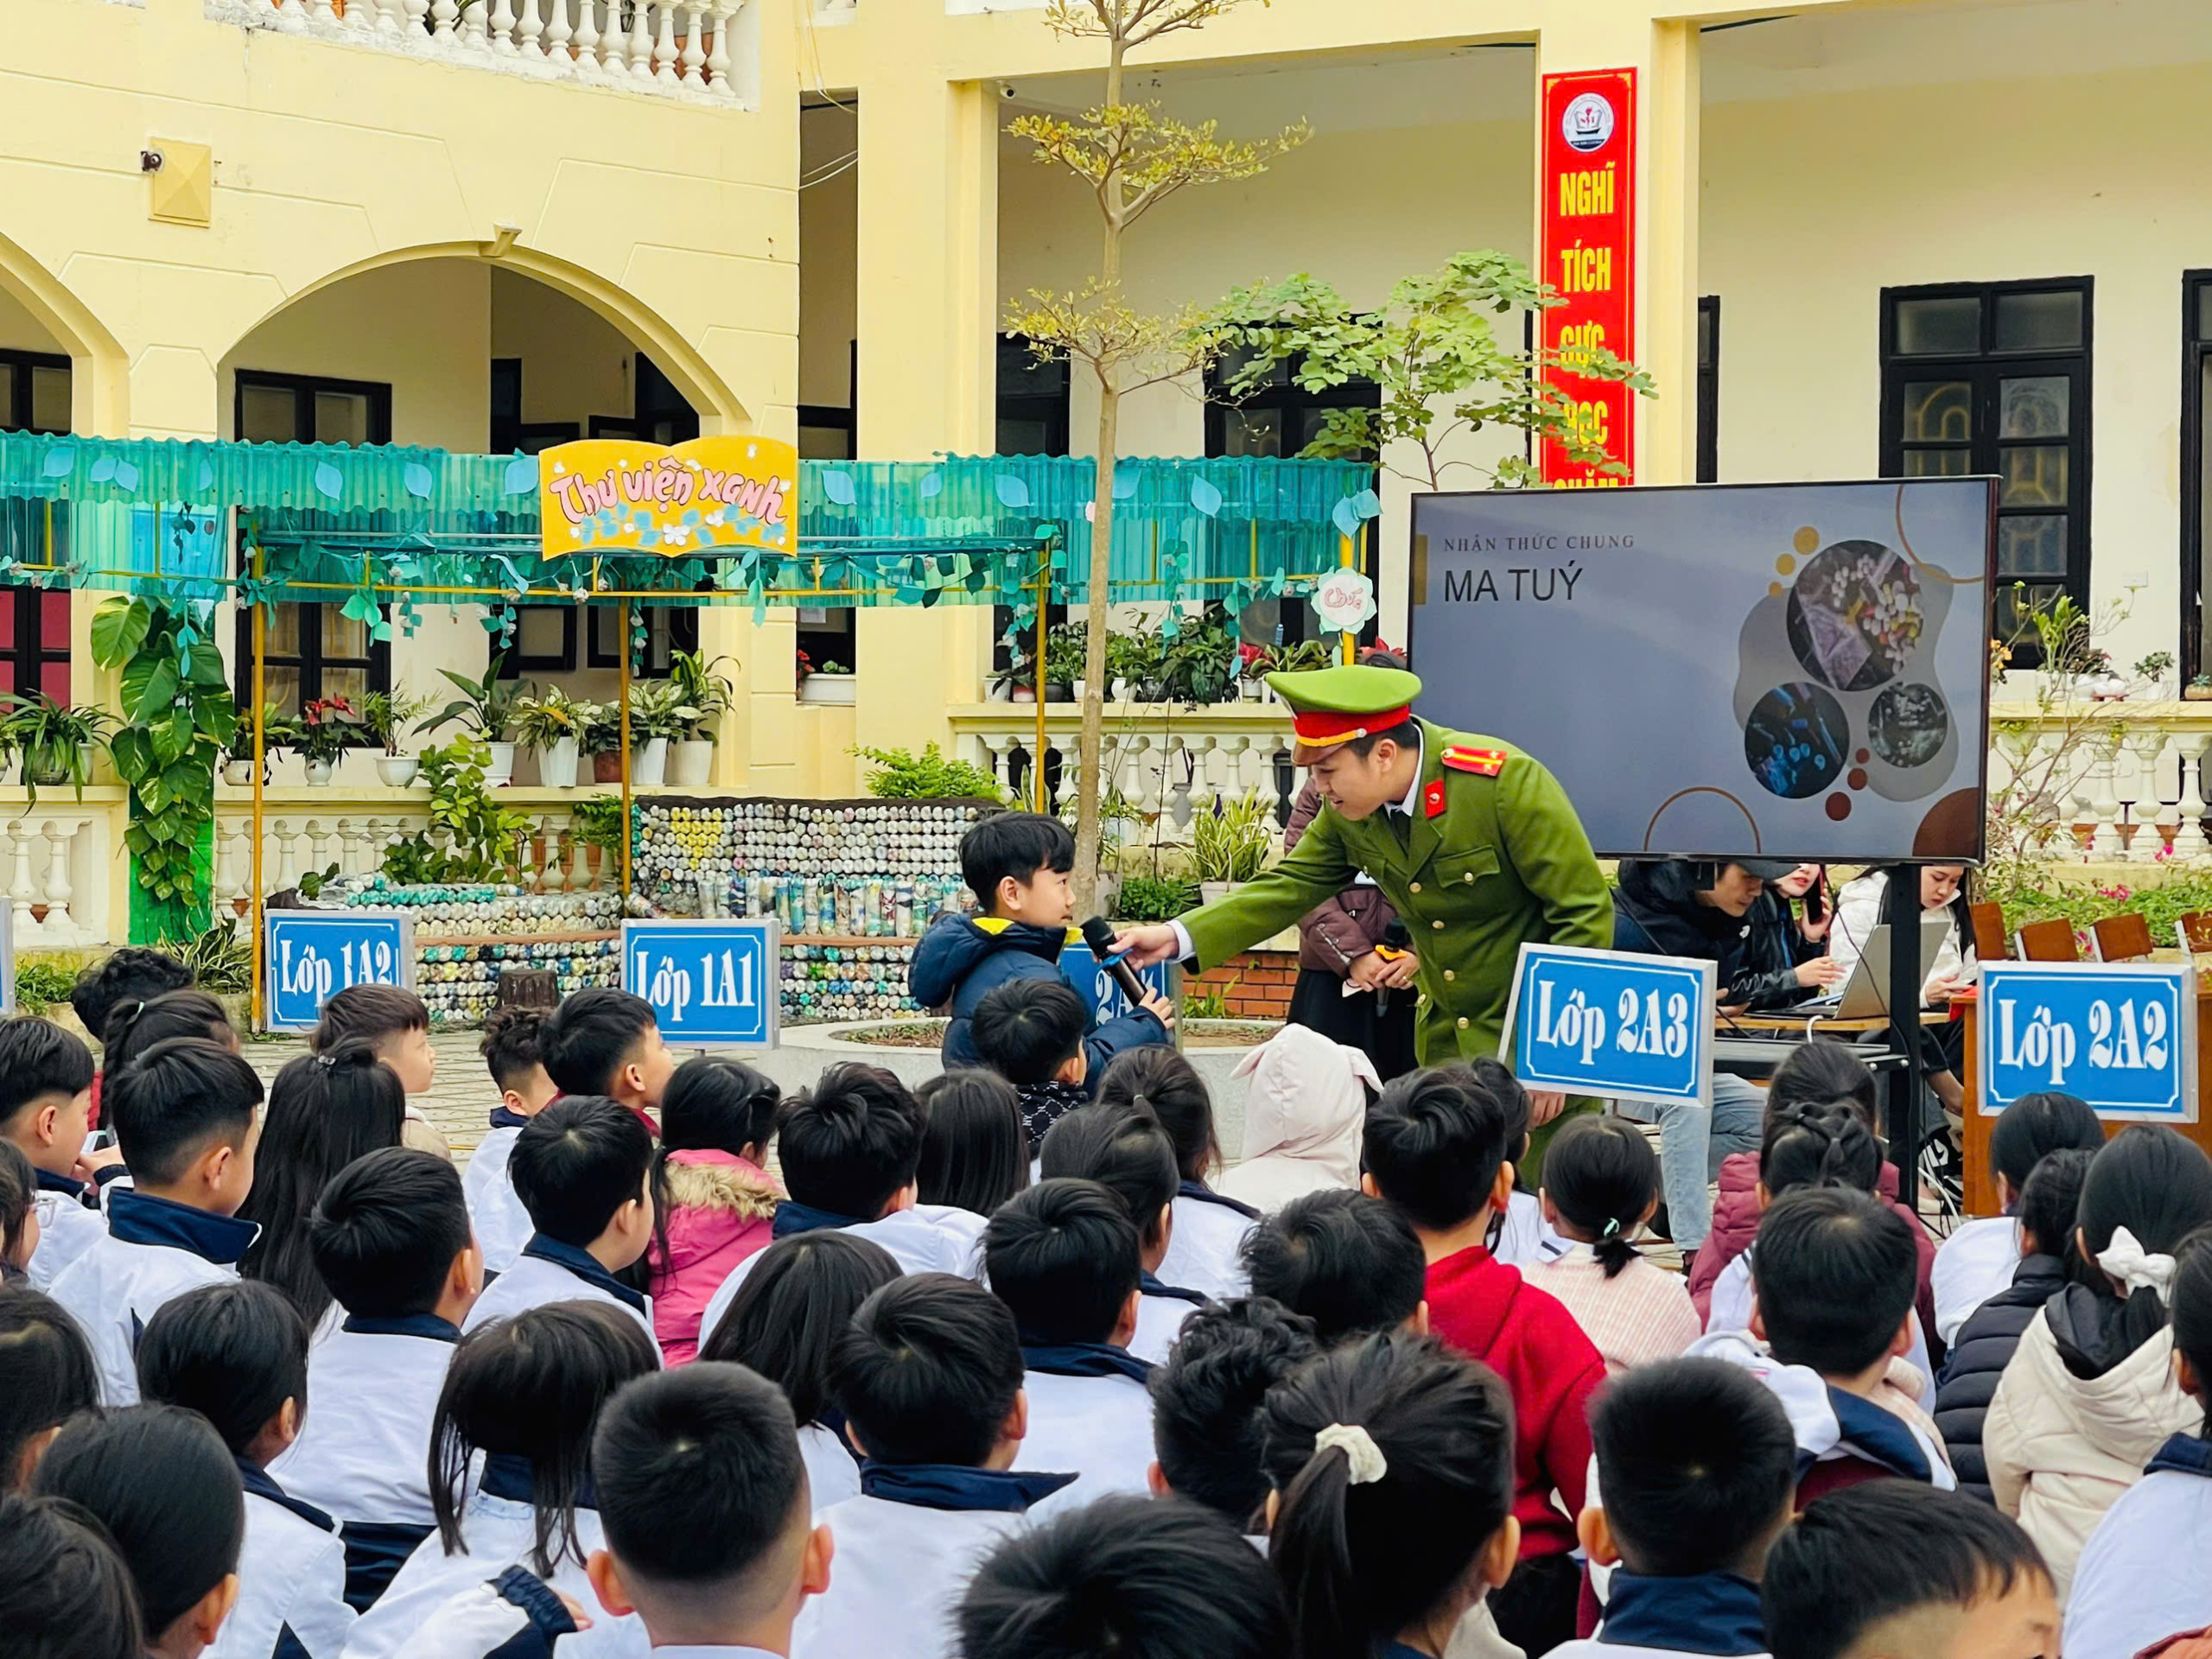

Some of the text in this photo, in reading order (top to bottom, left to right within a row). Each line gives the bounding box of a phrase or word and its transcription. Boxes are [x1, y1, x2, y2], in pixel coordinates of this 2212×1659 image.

[1560, 161, 1615, 216] NGHĨ
[1560, 238, 1611, 293] TÍCH
[550, 469, 620, 524] Thư
[621, 455, 695, 513] viện
[1444, 532, 1635, 553] NHẬN THỨC CHUNG
[1445, 559, 1584, 602] MA TUÝ
[280, 938, 392, 1007] Lớp 1A2
[636, 948, 756, 1021] Lớp 1A1
[1536, 980, 1689, 1065] Lớp 2A3
[1999, 997, 2169, 1085] Lớp 2A2
